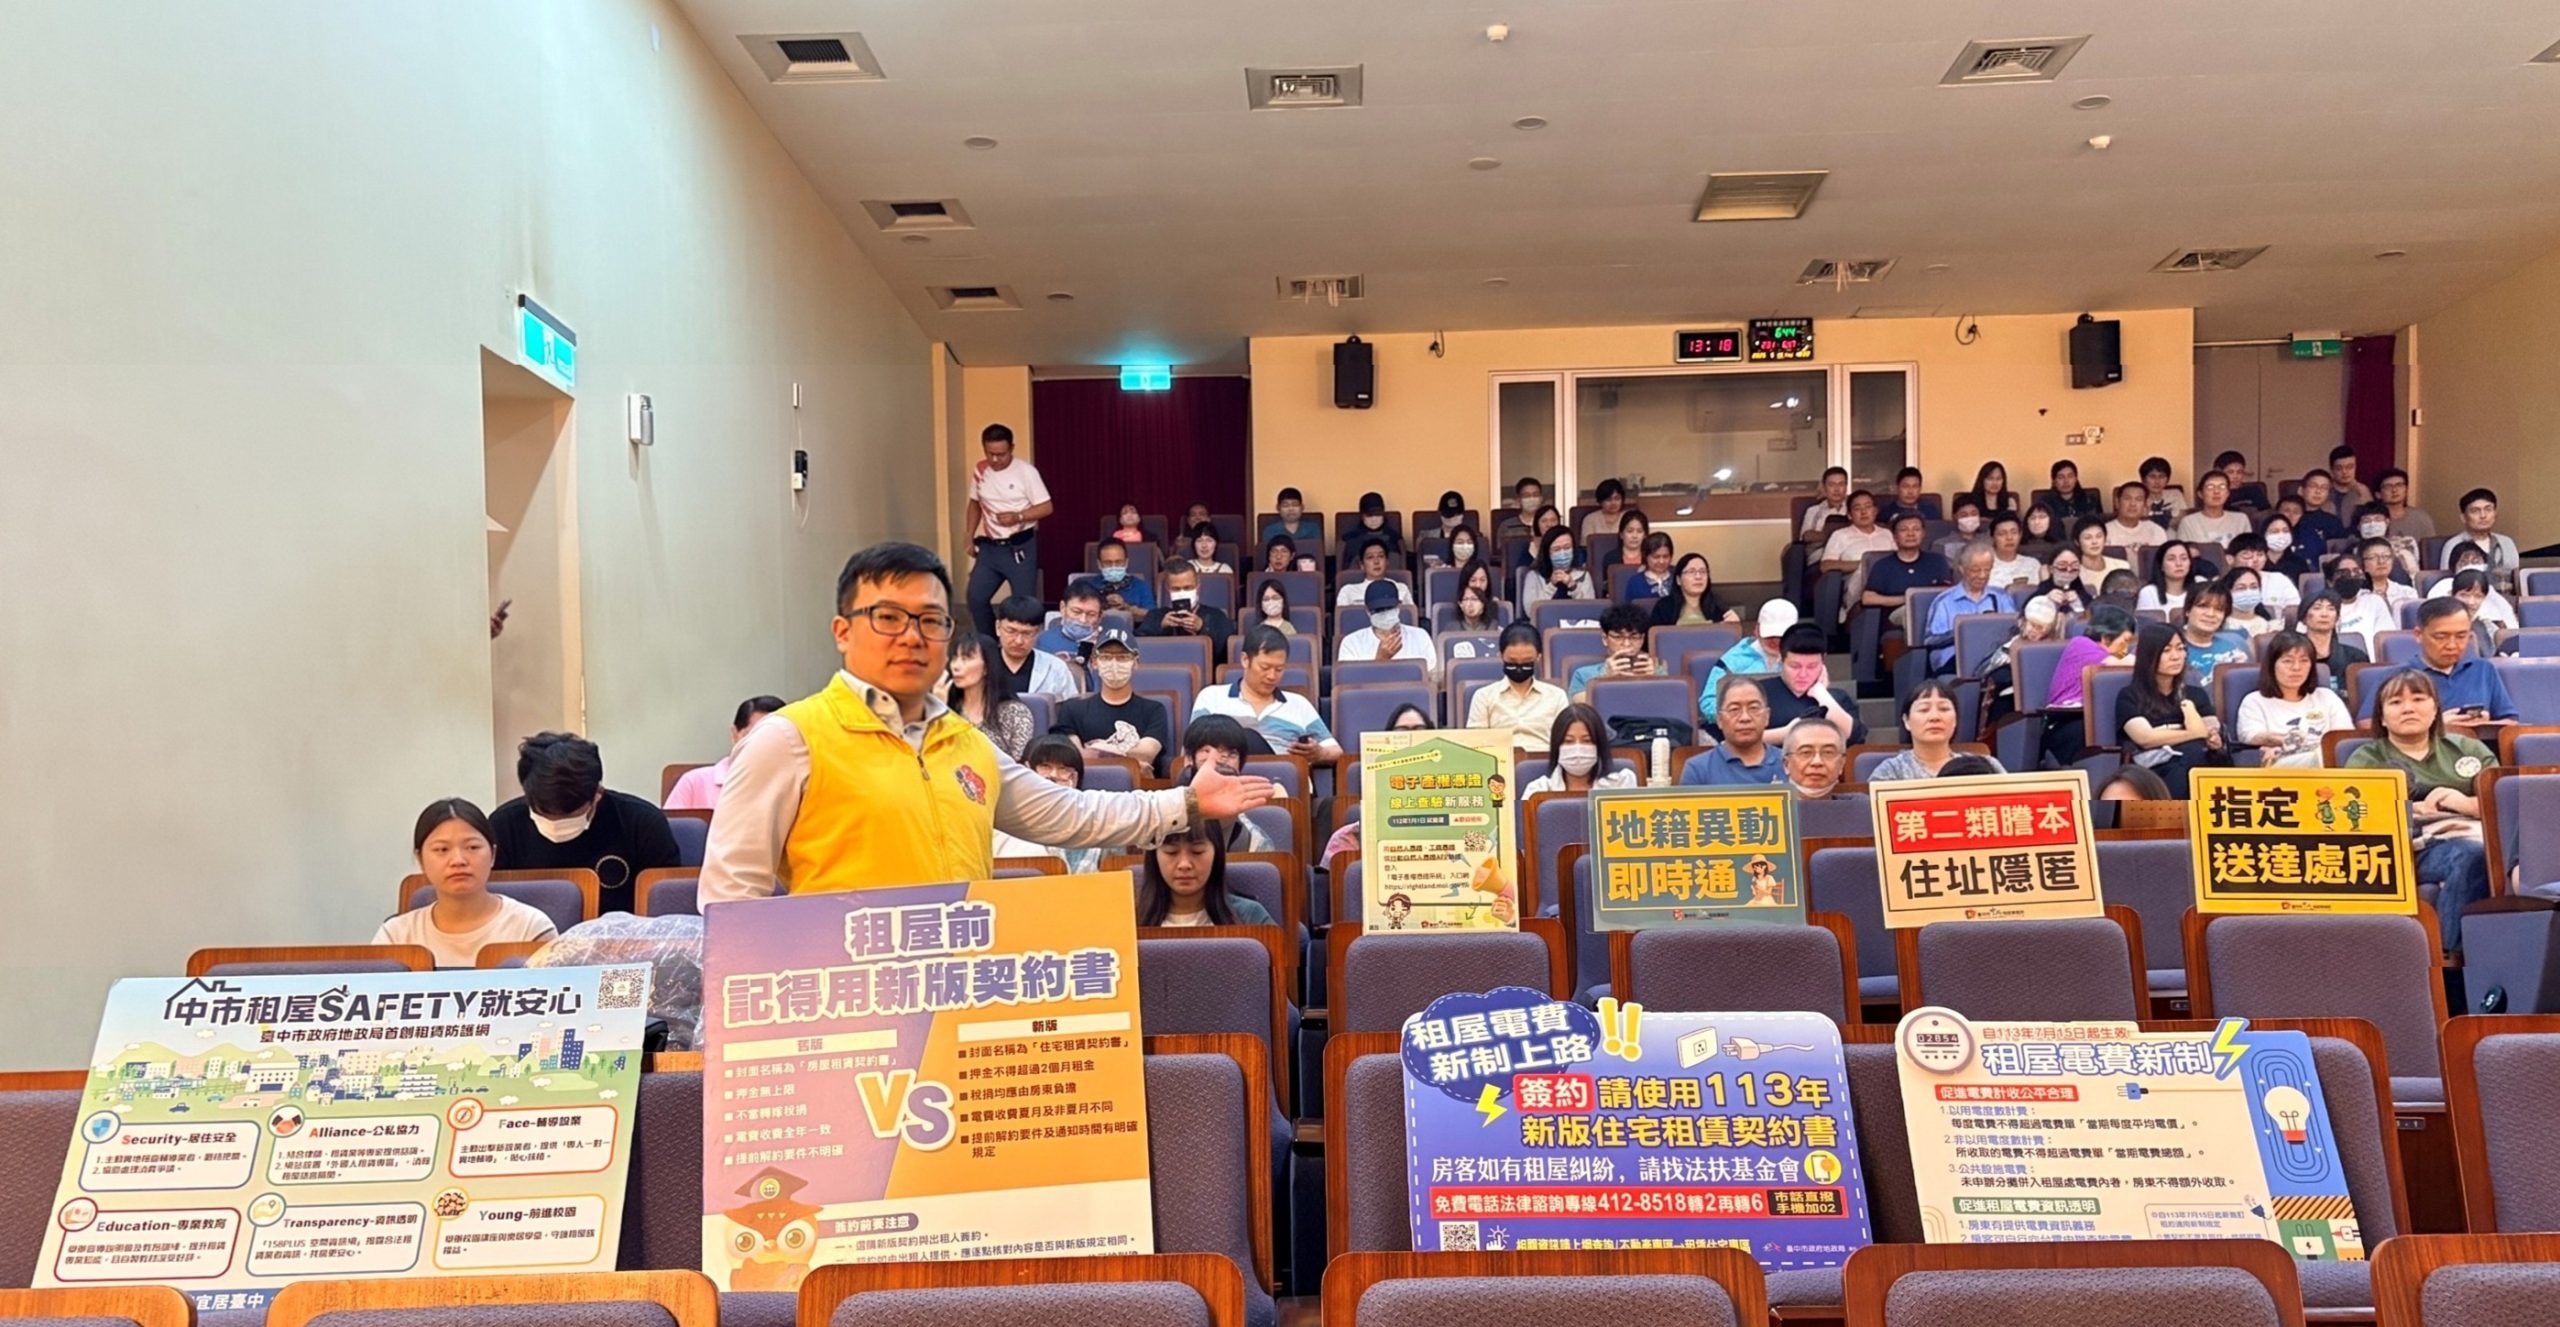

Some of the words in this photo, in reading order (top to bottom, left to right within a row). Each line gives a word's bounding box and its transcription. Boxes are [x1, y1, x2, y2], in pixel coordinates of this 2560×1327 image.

[1689, 339, 1733, 352] 13:18
[1389, 774, 1483, 790] 電子產權憑證
[1390, 795, 1484, 810] 線上查驗新服務
[2209, 786, 2300, 828] 指定
[1606, 807, 1780, 849] 地籍異動
[1894, 803, 2071, 842] 第二類謄本
[2212, 843, 2392, 885] 送達處所
[1607, 858, 1739, 901] 即時通
[1900, 851, 2080, 899] 住址隱匿
[847, 903, 994, 958] 租屋前
[725, 950, 1118, 1026] 記得用新版契約書
[174, 985, 582, 1026] 中市租屋SAFETY就安心
[1031, 1019, 1058, 1033] 新版
[1408, 1003, 1571, 1051] 租屋電費
[1982, 1026, 2129, 1039] 自113年7月15日起生效
[797, 1037, 823, 1052] 舊版
[968, 1036, 1130, 1059] 封面名稱為「住宅租賃契約書」
[1916, 1033, 1959, 1043] 02854
[1429, 1033, 1593, 1082] 新制上路
[1981, 1042, 2214, 1076] 租屋電費新制
[969, 1059, 1096, 1080] 押金不得超過2個月租金
[735, 1083, 795, 1100] 押金無上限
[970, 1082, 1077, 1101] 稅捐均應由房東負擔
[1519, 1077, 1588, 1109] 簽約
[1597, 1072, 1831, 1110] 請使用113年
[1940, 1086, 2076, 1100] 促進電費計收公平合理
[857, 1070, 953, 1148] VS
[970, 1101, 1114, 1123] 電費收費夏月及非夏月不同
[122, 1132, 238, 1146] Security-居住安全
[309, 1125, 420, 1138] Alliance-公私協力
[735, 1124, 832, 1143] 電費收費全年一致
[971, 1121, 1138, 1145] 提前解約要件及通知時間有明確
[1522, 1115, 1837, 1148] 新版住宅租賃契約書
[735, 1144, 844, 1165] 提前解約要件不明確
[972, 1145, 997, 1159] 規定
[1774, 1190, 1835, 1202] 市話直撥
[479, 1206, 577, 1222] Young-前進校園
[1776, 1203, 1836, 1215] 手機加02
[96, 1218, 227, 1232] Education-專業教育
[283, 1214, 418, 1229] Transparency-資訊透明
[197, 1293, 265, 1310] 宜居臺中
